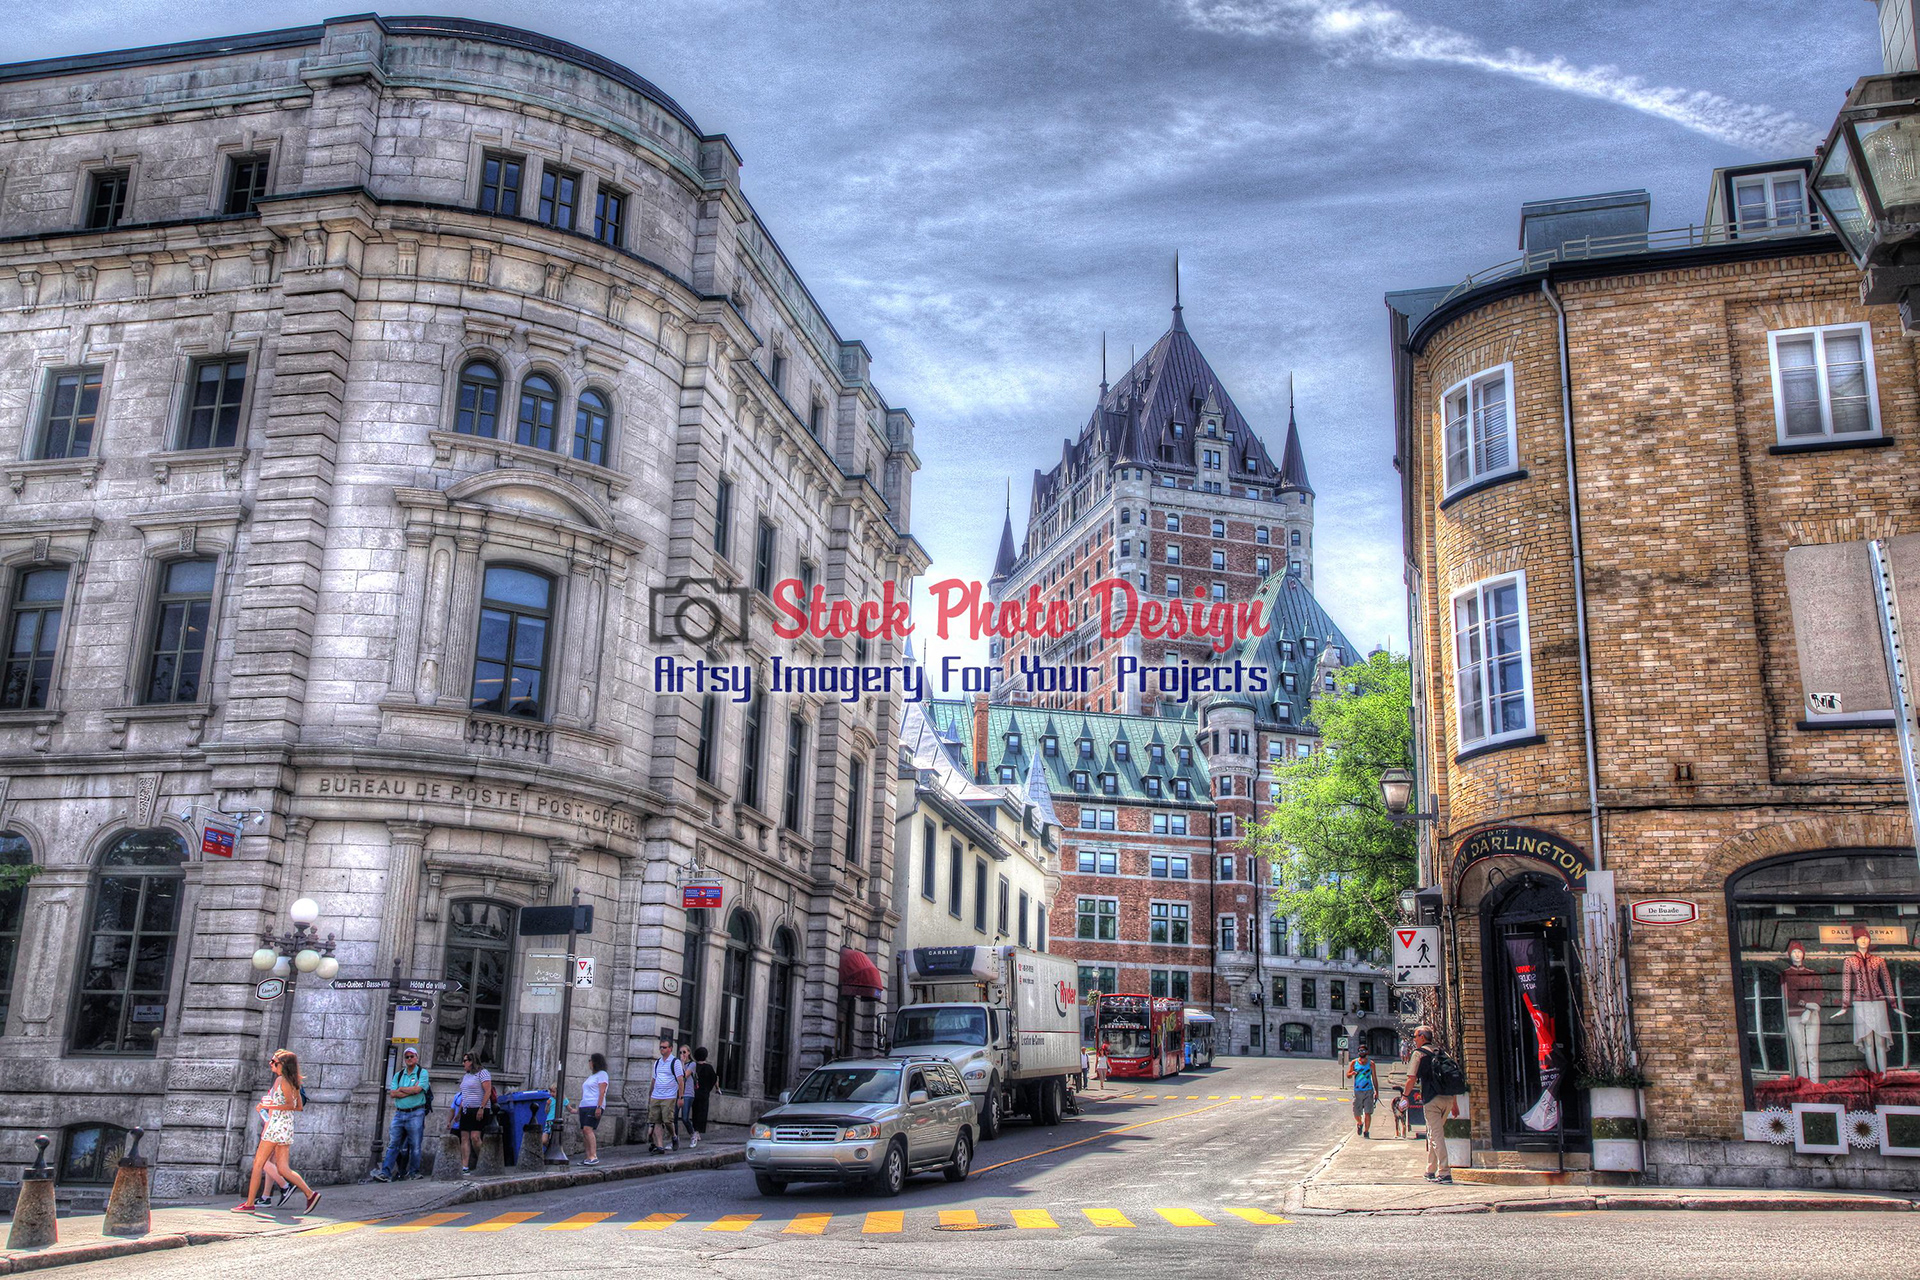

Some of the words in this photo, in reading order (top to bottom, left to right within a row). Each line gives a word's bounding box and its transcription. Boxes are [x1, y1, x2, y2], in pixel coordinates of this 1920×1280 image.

[319, 778, 406, 795] BUREAU
[415, 782, 442, 798] DE
[451, 785, 520, 807] POSTE
[538, 797, 635, 833] POST-OFFICE
[1470, 836, 1589, 880] DARLINGTON
[409, 980, 425, 989] Hôtel
[425, 981, 434, 989] de
[1060, 980, 1076, 1010] Ryder
